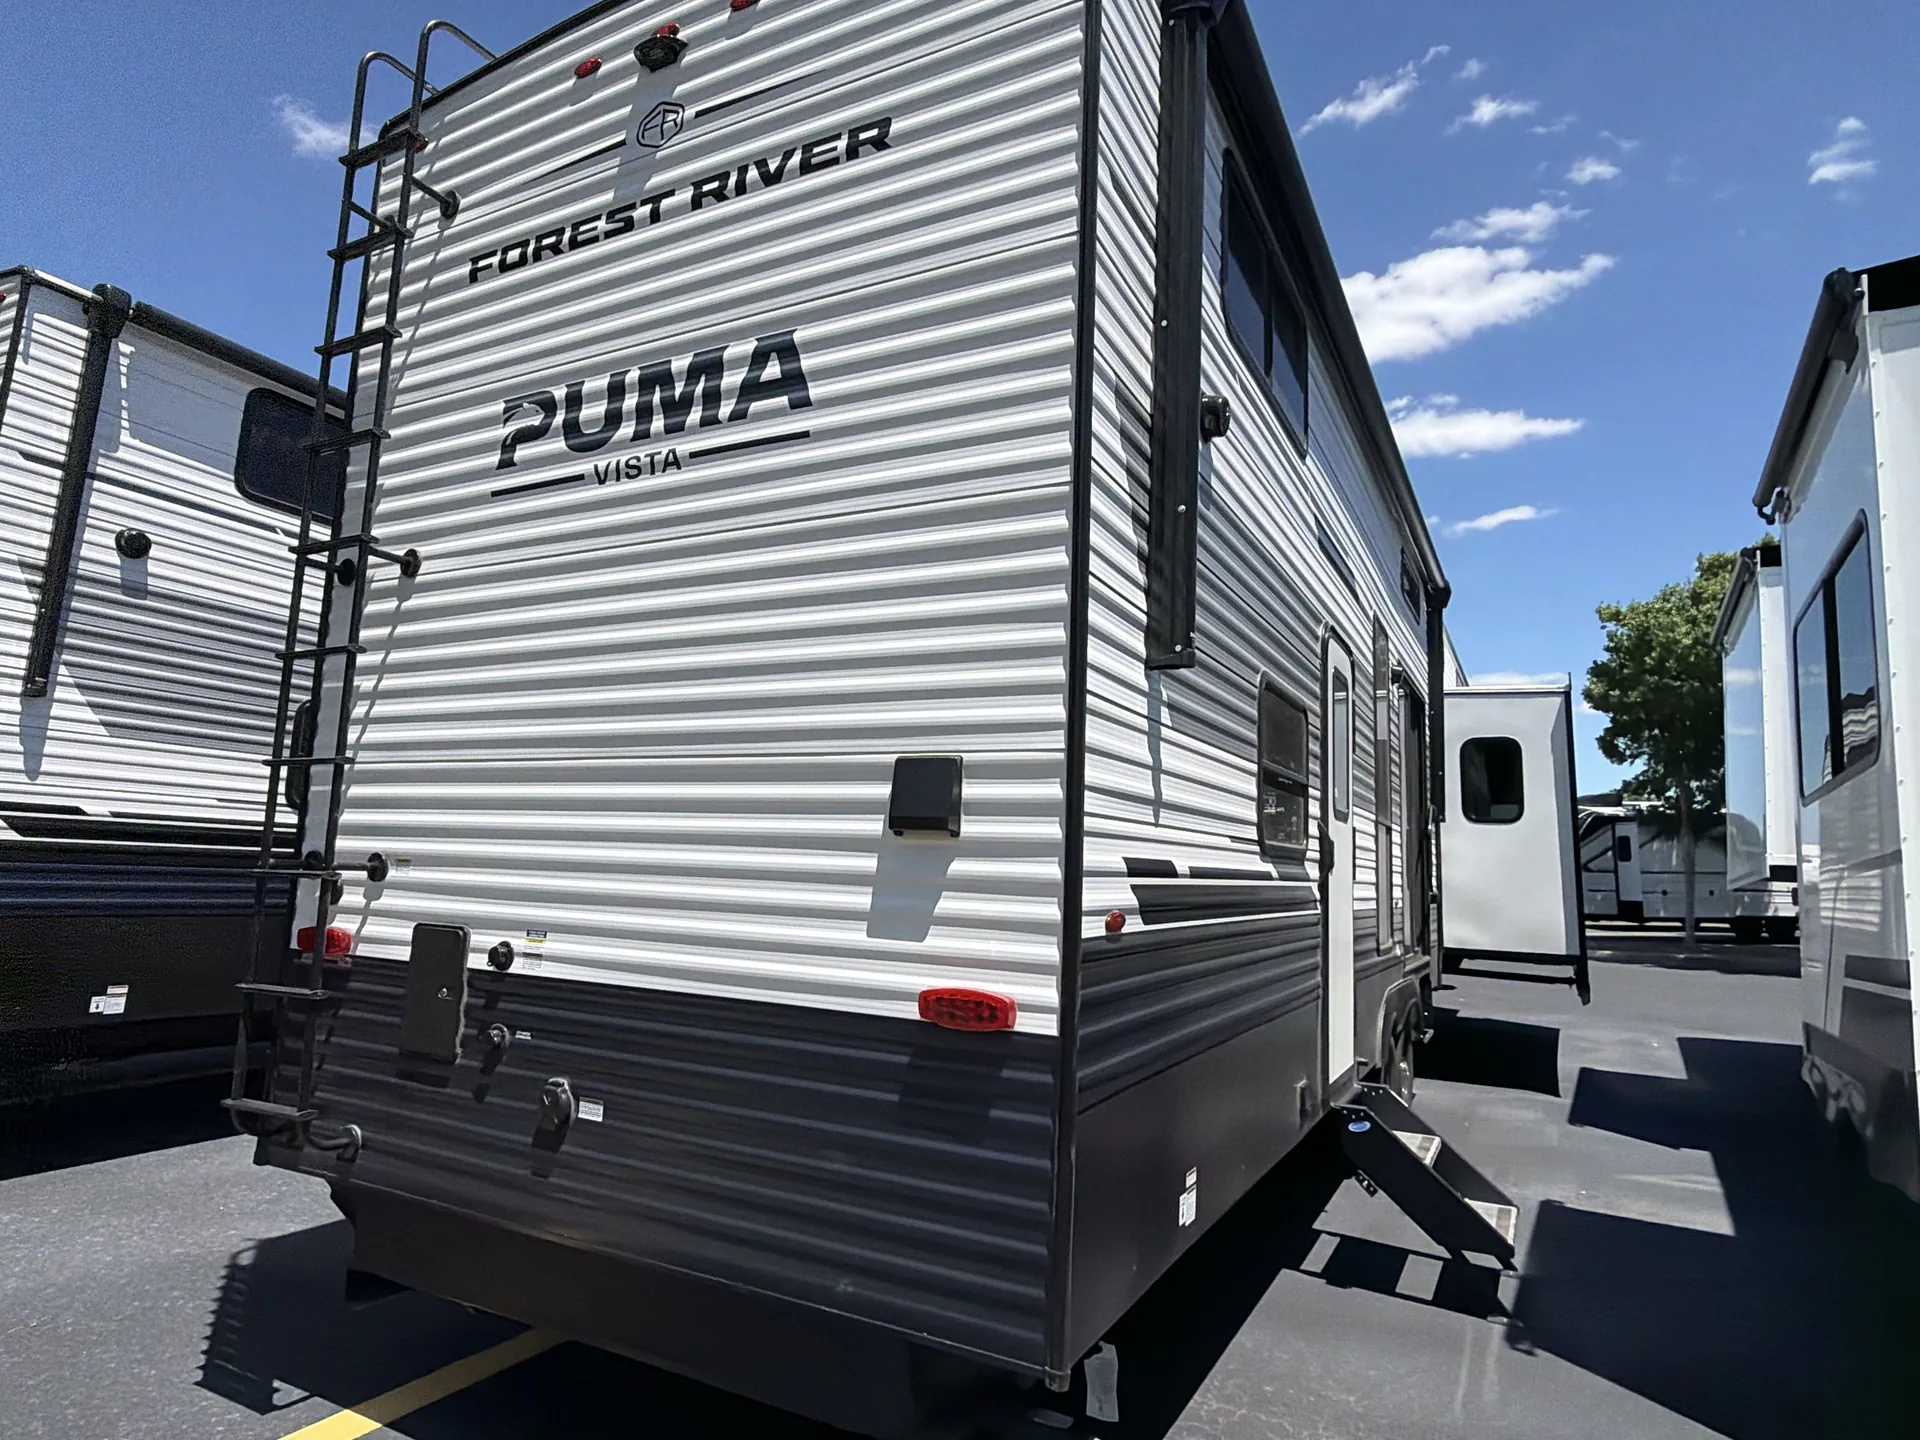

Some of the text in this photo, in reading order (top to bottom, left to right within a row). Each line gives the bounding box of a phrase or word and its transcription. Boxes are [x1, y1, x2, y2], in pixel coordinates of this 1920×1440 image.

[469, 116, 893, 284] FOREST RIVER
[495, 329, 813, 470] PUMA
[594, 448, 682, 485] VISTA
